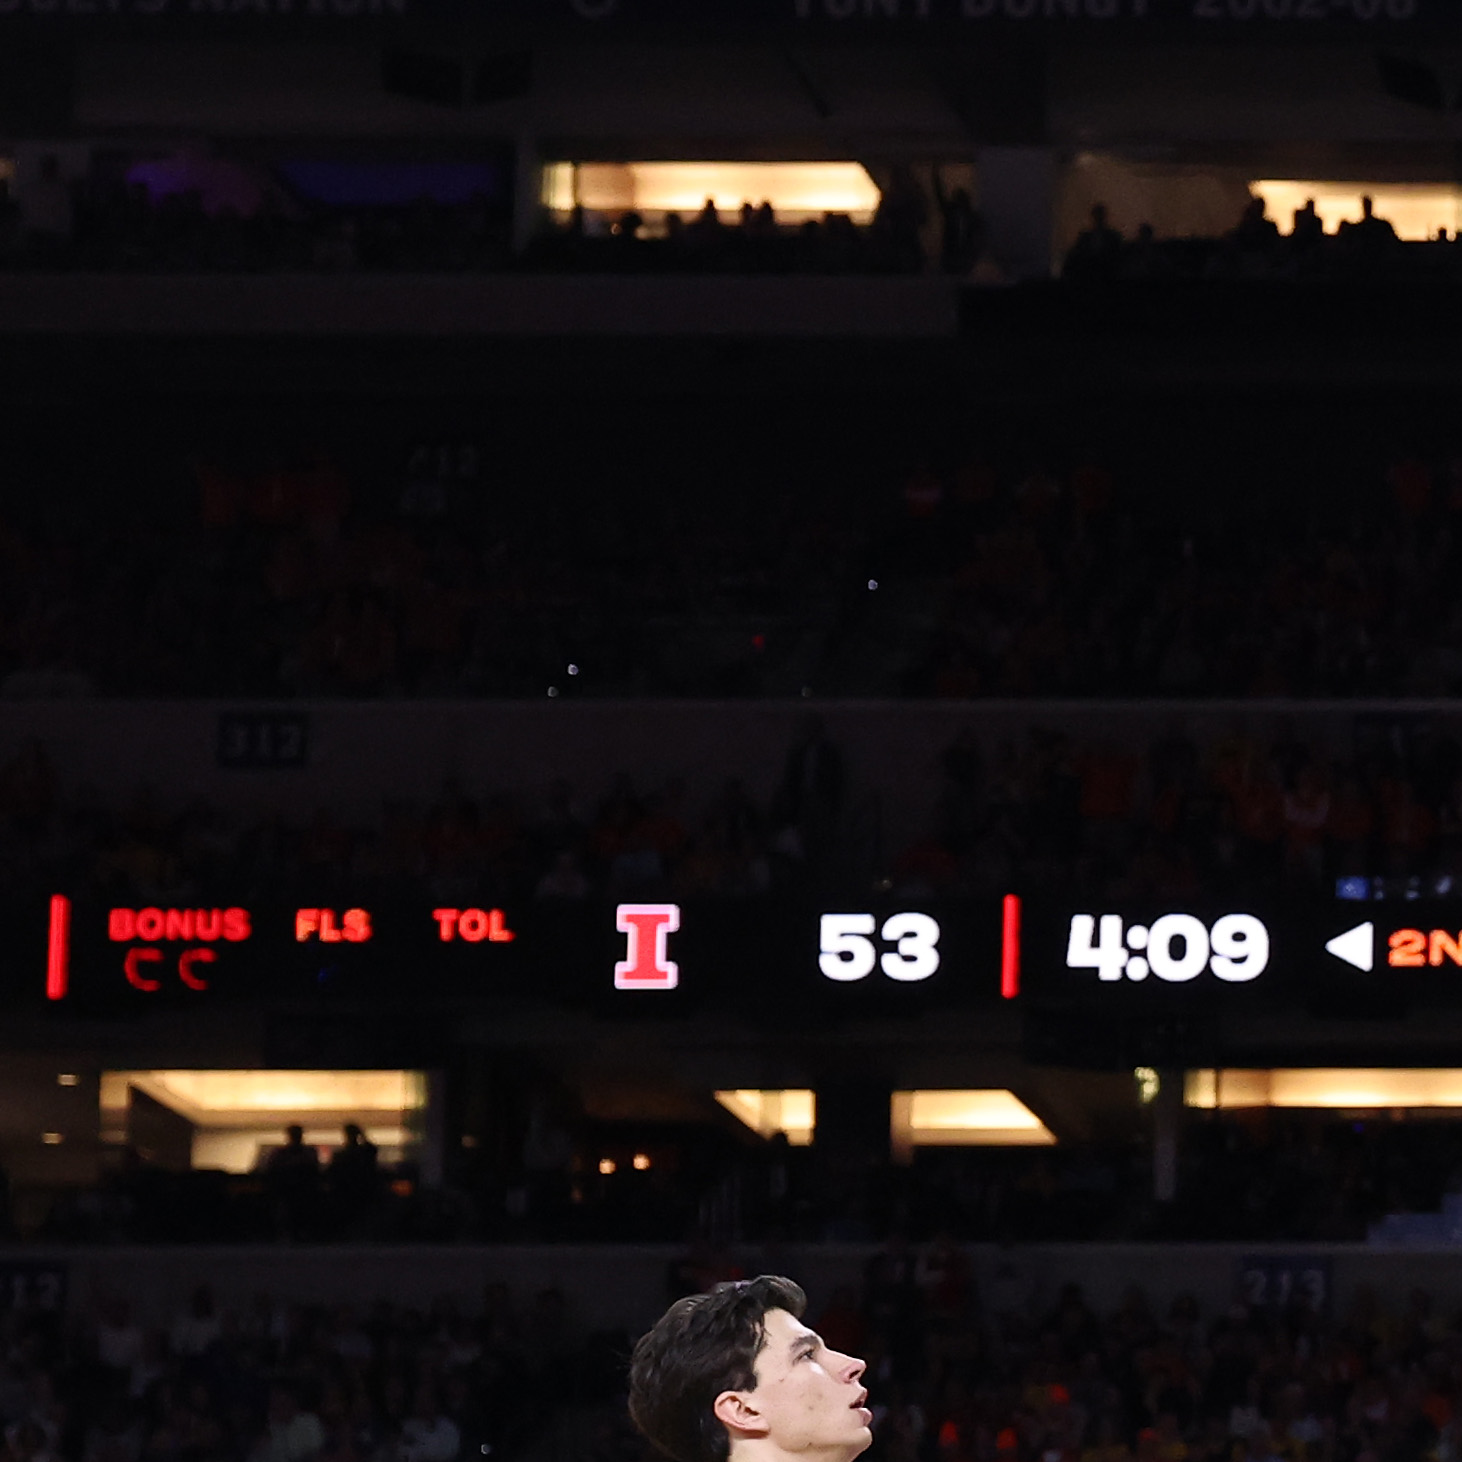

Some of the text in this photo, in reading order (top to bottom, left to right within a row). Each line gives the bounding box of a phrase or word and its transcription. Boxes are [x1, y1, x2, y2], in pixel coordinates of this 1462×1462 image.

[108, 906, 517, 943] BONUS FLS TOL
[818, 911, 942, 982] 53
[1066, 913, 1270, 982] 4:09
